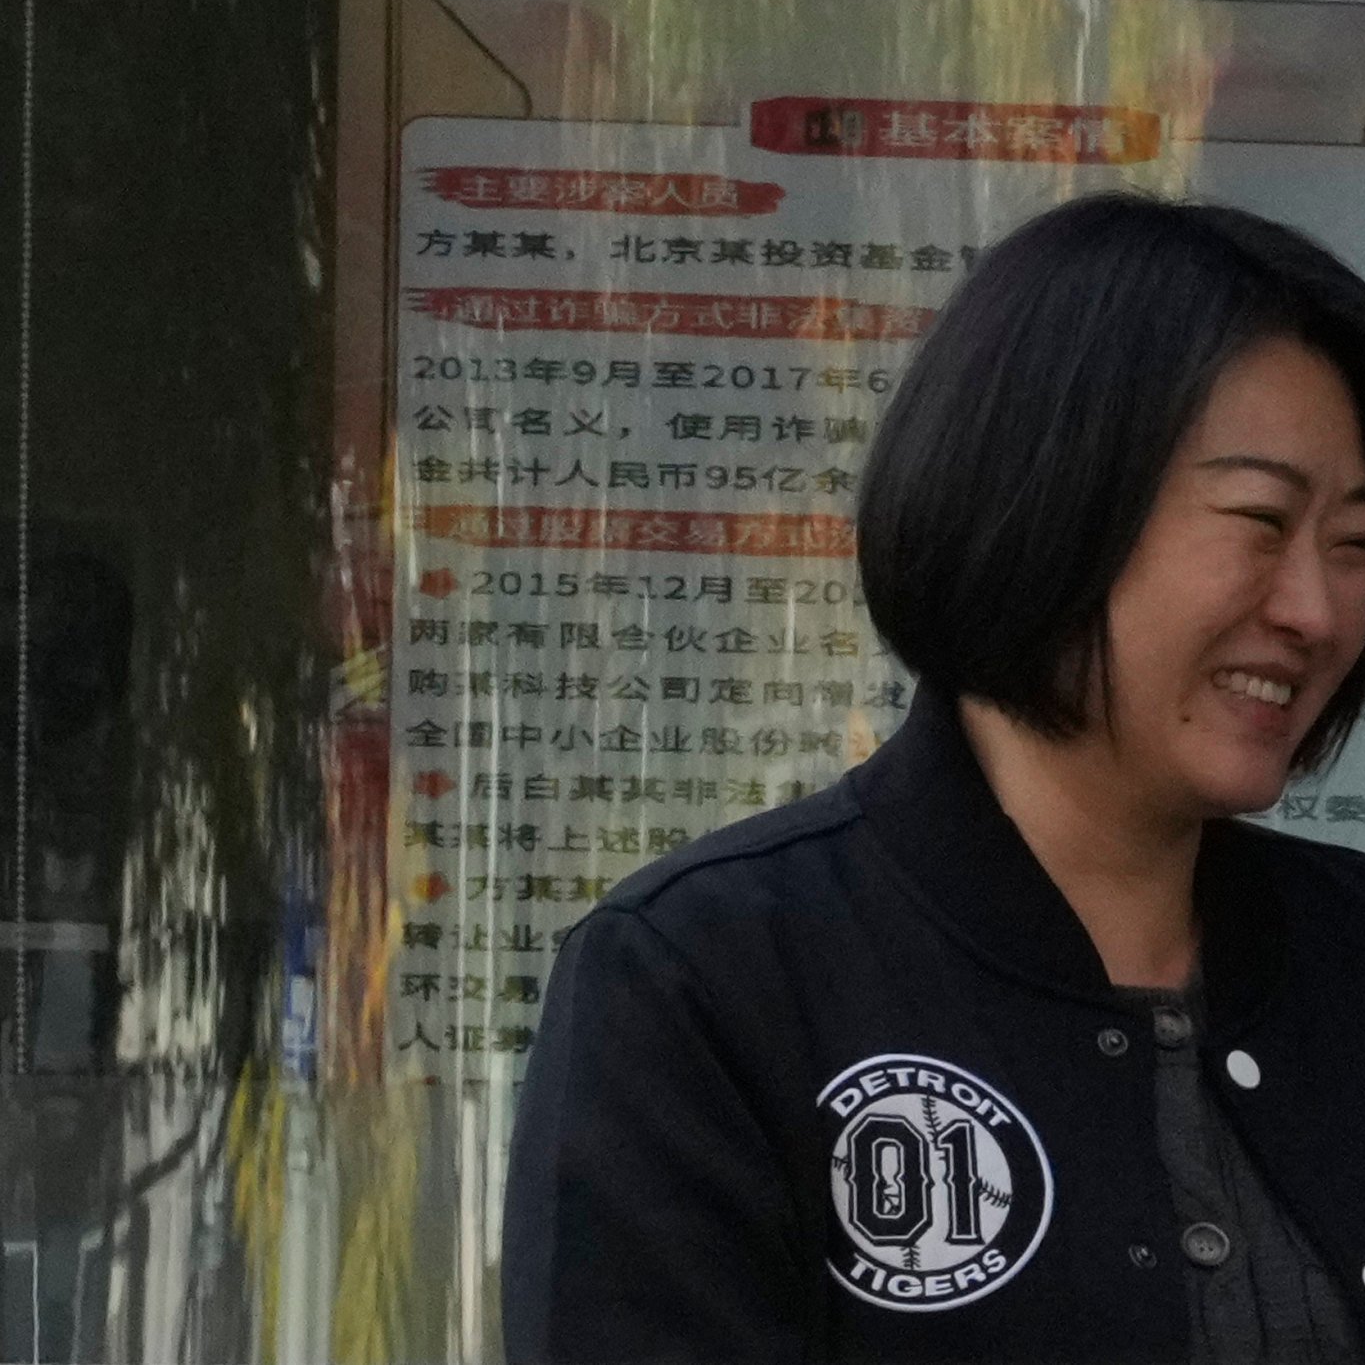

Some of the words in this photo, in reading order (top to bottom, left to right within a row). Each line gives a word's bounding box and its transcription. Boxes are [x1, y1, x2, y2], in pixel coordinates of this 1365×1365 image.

[459, 172, 740, 213] 主要涉案人员
[830, 1067, 1011, 1127] DETROIT
[846, 1113, 985, 1246] 01
[850, 1248, 1007, 1297] TIGERS
